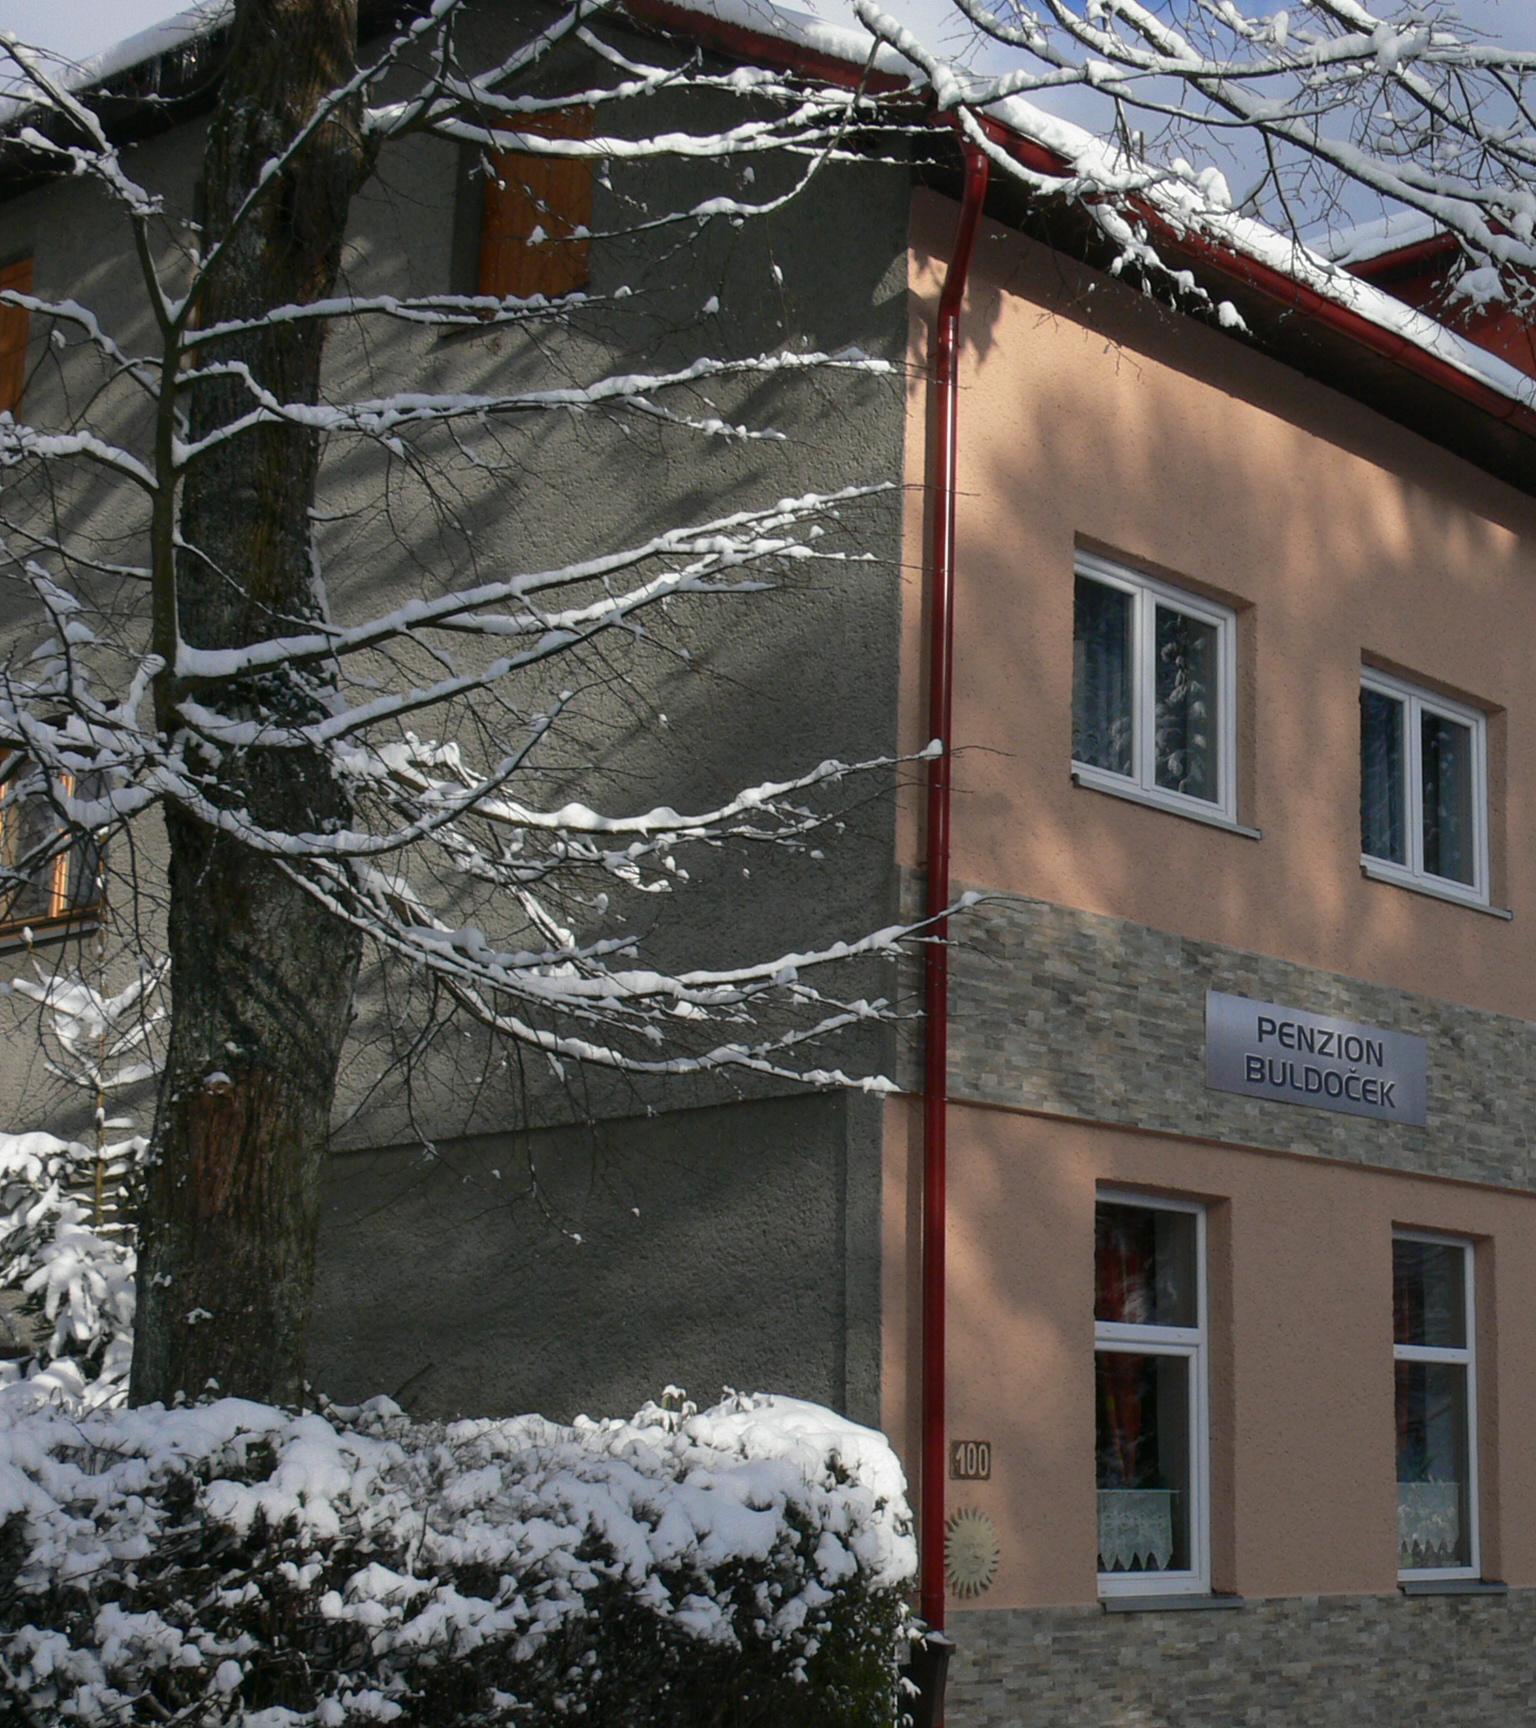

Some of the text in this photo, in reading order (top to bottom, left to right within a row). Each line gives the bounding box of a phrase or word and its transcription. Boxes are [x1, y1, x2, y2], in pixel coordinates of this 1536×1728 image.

[1257, 1016, 1384, 1068] PENZION
[1245, 1054, 1396, 1109] BULDOČEK
[955, 1442, 989, 1476] 100
